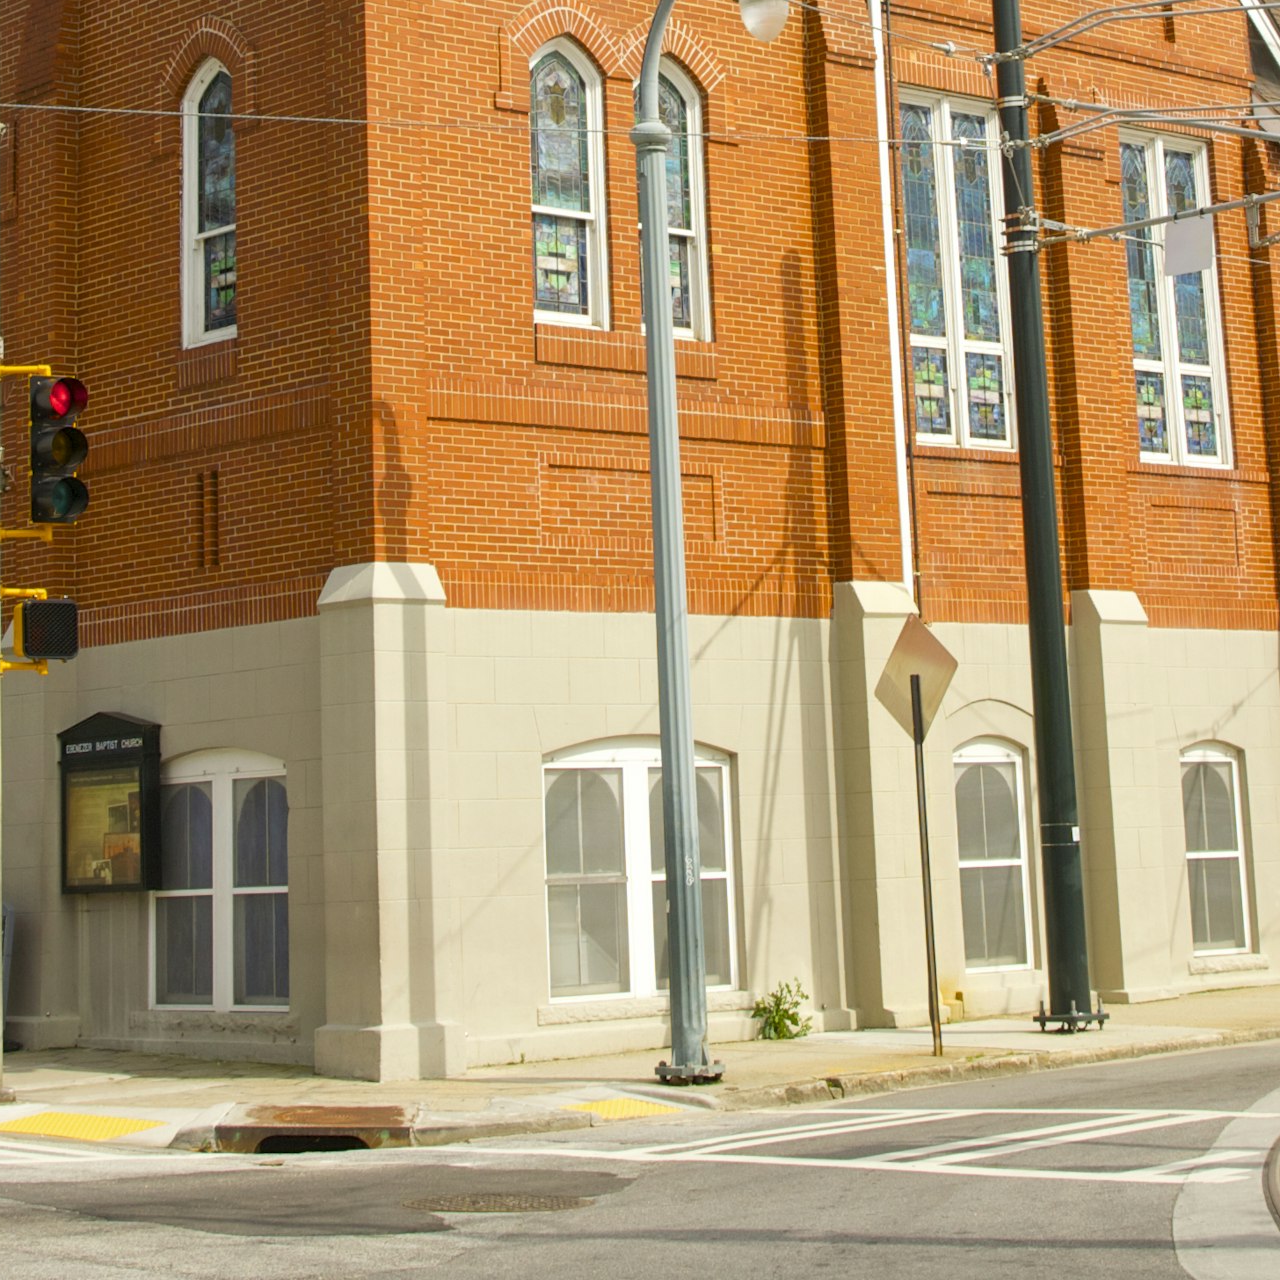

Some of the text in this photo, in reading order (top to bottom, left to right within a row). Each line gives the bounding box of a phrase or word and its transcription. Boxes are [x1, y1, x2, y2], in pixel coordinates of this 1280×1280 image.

[66, 738, 142, 754] EBENEZER BAPTIST CHURCH
